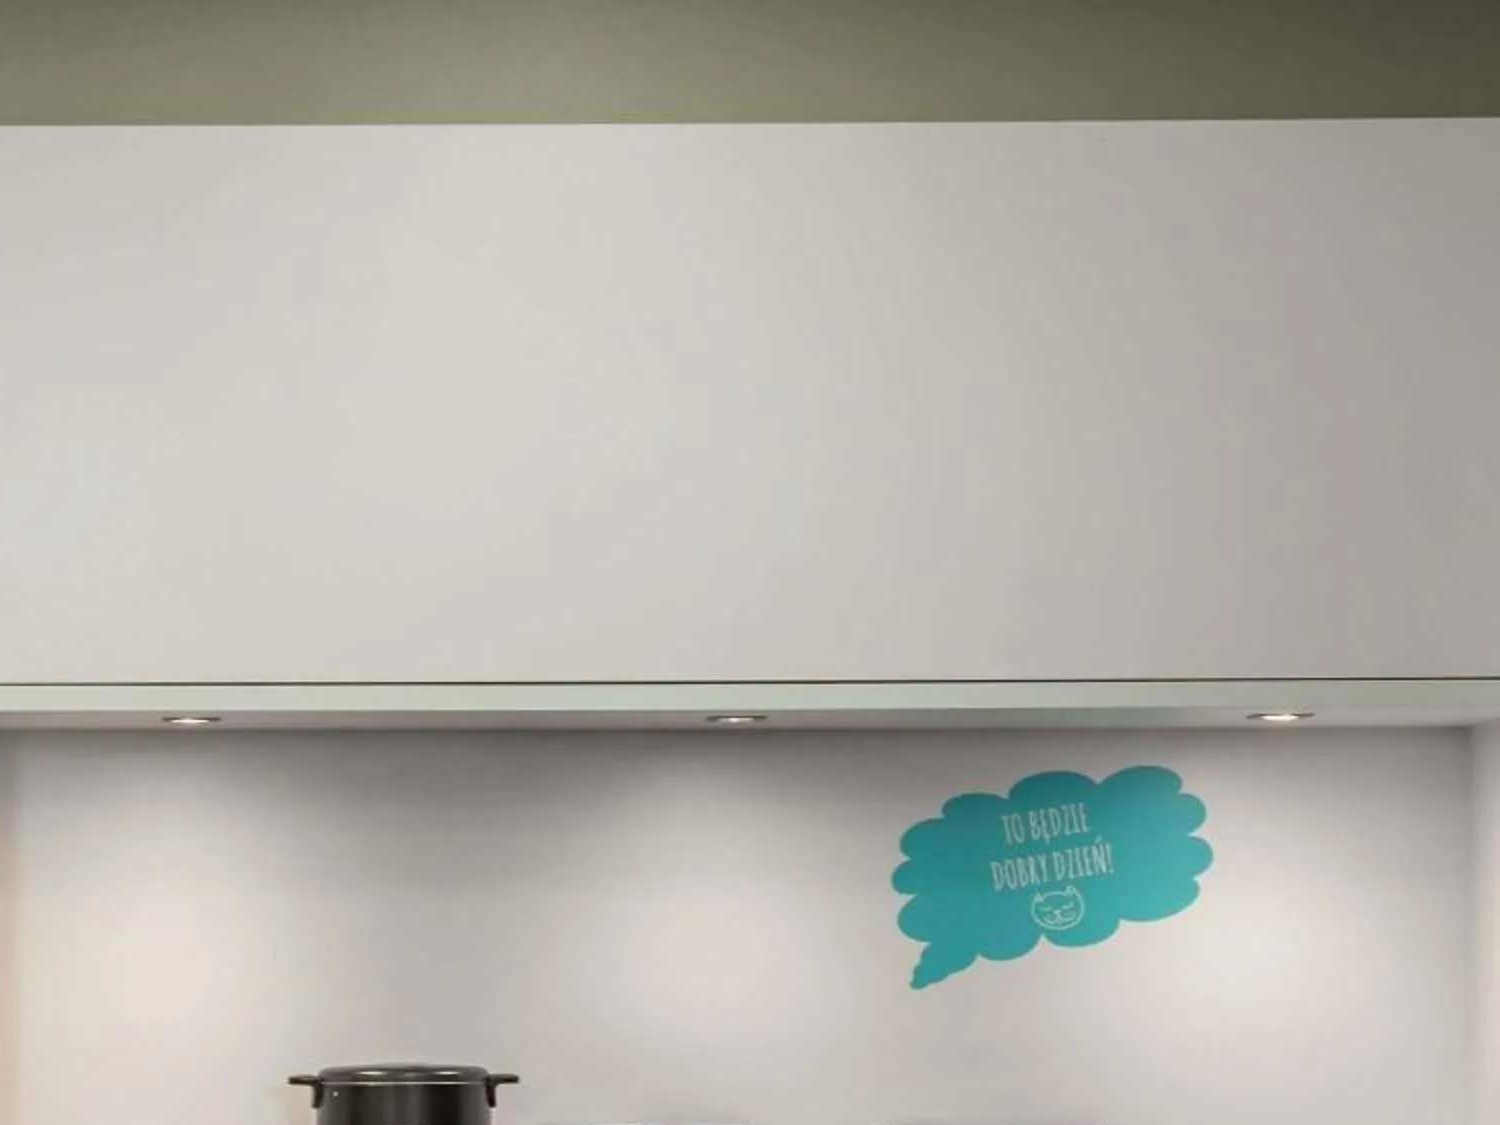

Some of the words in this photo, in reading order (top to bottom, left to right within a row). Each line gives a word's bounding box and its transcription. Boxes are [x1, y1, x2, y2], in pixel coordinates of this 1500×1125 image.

[1001, 812, 1025, 846] TO
[1028, 802, 1089, 845] BĘDZIE
[990, 854, 1047, 891] DOBRY
[1052, 836, 1114, 881] DZIEŃ!
